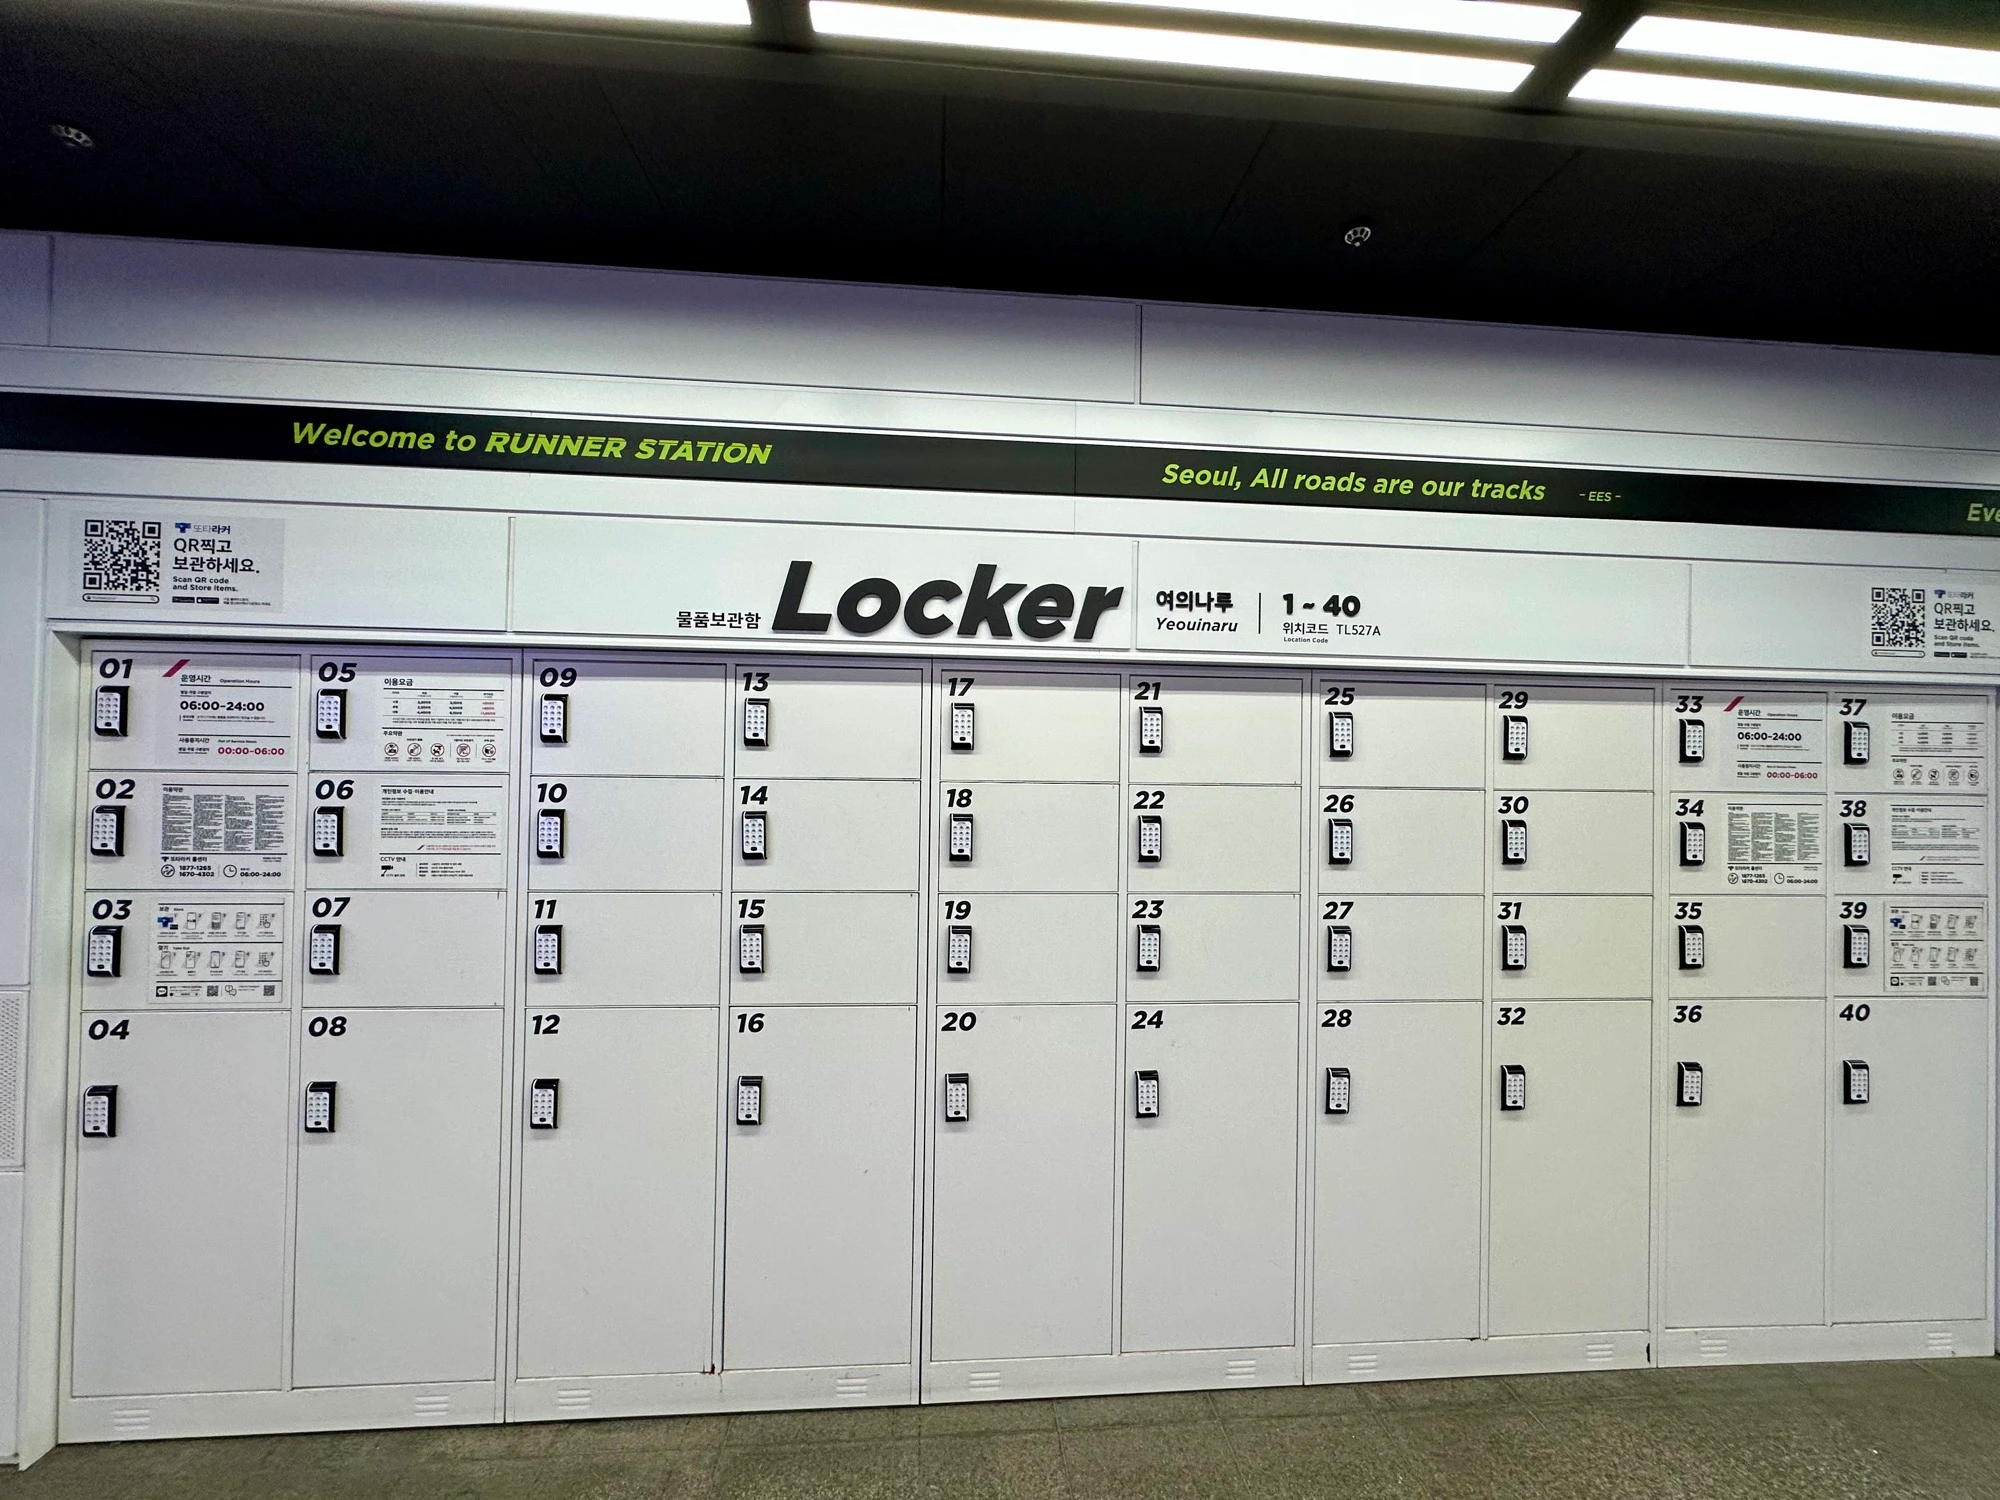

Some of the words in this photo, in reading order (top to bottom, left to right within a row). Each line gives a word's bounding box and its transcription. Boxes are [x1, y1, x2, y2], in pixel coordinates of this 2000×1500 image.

[293, 423, 435, 450] Welcome
[445, 430, 477, 452] to
[485, 431, 627, 458] RUNNER
[635, 437, 772, 465] STATION
[1162, 463, 1241, 489] Seoul,
[1250, 468, 1288, 488] All
[1294, 472, 1365, 493] roads
[1372, 477, 1414, 495] are
[1421, 480, 1464, 496] our
[1471, 480, 1545, 501] tracks
[193, 524, 231, 535] 또타라커
[173, 537, 233, 554] QR찍고
[172, 556, 260, 574] 보관하세요.
[194, 576, 207, 584] QR
[771, 559, 1125, 640] Locker
[1155, 589, 1234, 614] 여의나루
[1321, 593, 1362, 619] 40
[1933, 602, 1976, 617] QR찍고
[675, 610, 762, 629] 물품보관함
[1156, 617, 1239, 633] Yeouinaru
[1282, 621, 1330, 636] 위치코드
[1335, 623, 1382, 637] TL527A
[1933, 618, 1996, 633] 보관하세요.
[99, 657, 134, 679] 01
[318, 661, 358, 683] 05
[539, 666, 578, 688] 09
[180, 674, 212, 683] 운영시간
[384, 678, 414, 687] 이용요금
[742, 671, 771, 692] 13
[948, 677, 975, 697] 17
[1134, 681, 1162, 701] 21
[1324, 686, 1356, 706] 25
[1498, 690, 1529, 710] 29
[1674, 694, 1705, 714] 33
[1838, 697, 1868, 716] 37
[95, 778, 136, 800] 02
[315, 779, 355, 800] 06
[537, 783, 568, 804] 10
[740, 785, 768, 805] 14
[946, 788, 973, 808] 18
[1133, 790, 1165, 810] 22
[1323, 794, 1355, 813] 26
[1497, 795, 1529, 815] 30
[1675, 798, 1704, 817] 34
[1839, 799, 1867, 818] 38
[92, 898, 133, 921] 03
[312, 896, 351, 918] 07
[534, 899, 557, 919] 11
[738, 898, 766, 919] 15
[944, 900, 972, 920] 19
[1131, 899, 1165, 919] 23
[1322, 901, 1354, 920] 27
[1497, 901, 1522, 920] 31
[1674, 902, 1703, 920] 35
[1839, 901, 1868, 920] 39
[737, 1012, 765, 1033] 16
[940, 1011, 977, 1032] 20
[1131, 1009, 1164, 1030] 24
[1321, 1008, 1353, 1028] 28
[1496, 1006, 1526, 1026] 32
[1673, 1004, 1703, 1024] 36
[1839, 1003, 1871, 1022] 40
[88, 1019, 130, 1041] 04
[308, 1015, 348, 1038] 08
[532, 1014, 561, 1035] 12
